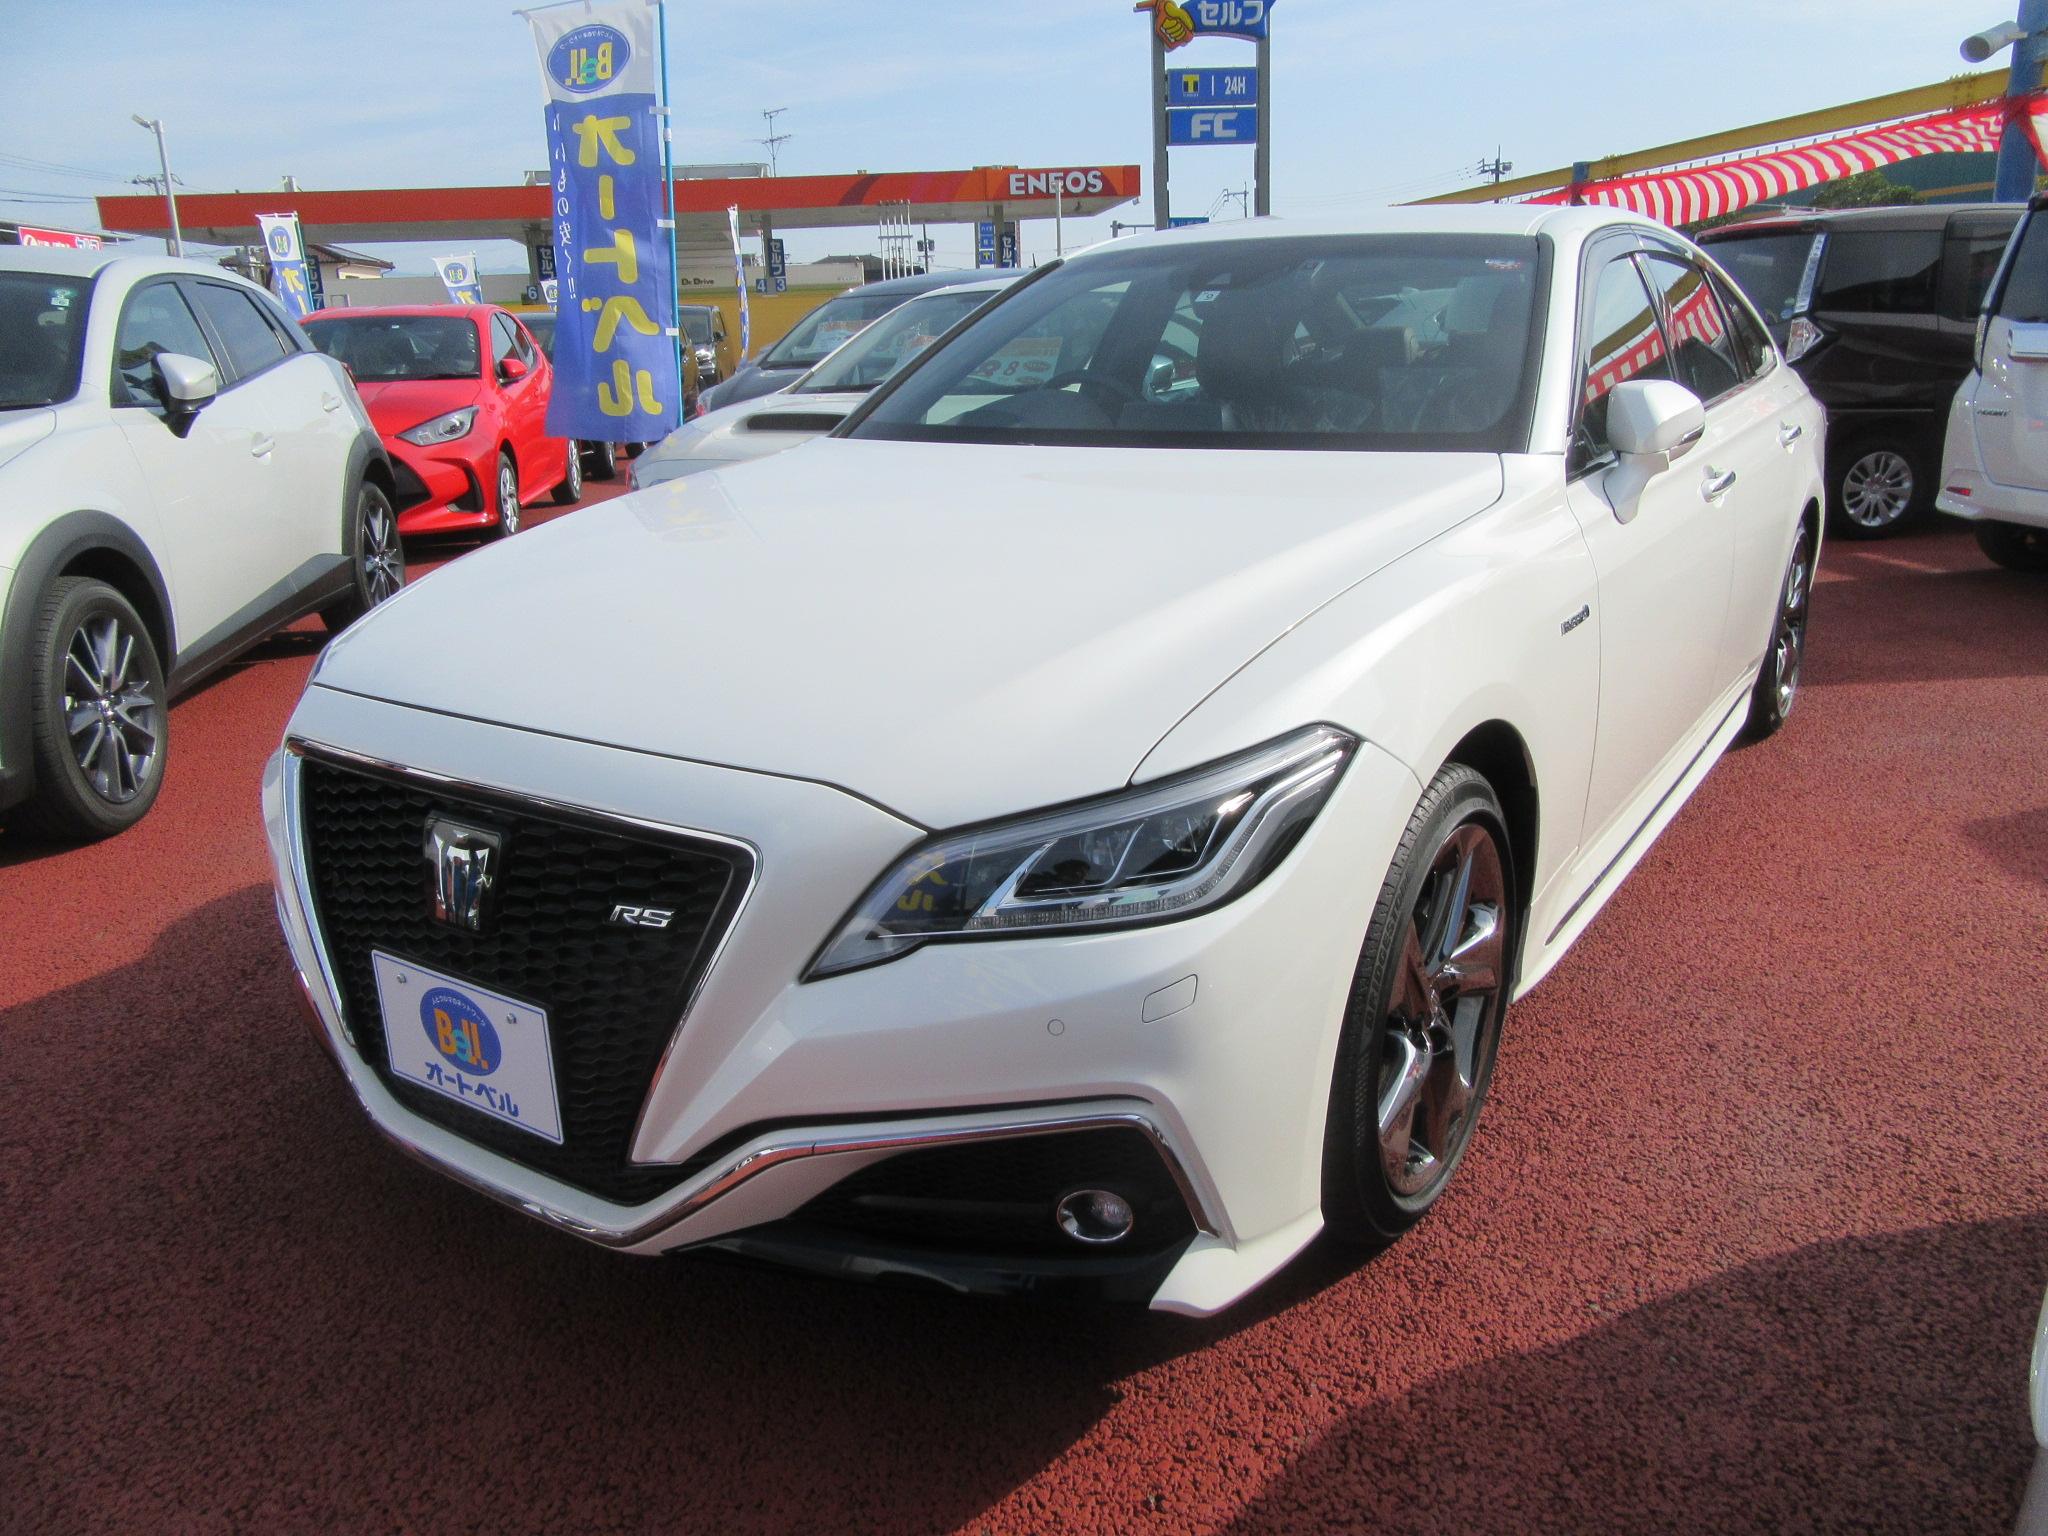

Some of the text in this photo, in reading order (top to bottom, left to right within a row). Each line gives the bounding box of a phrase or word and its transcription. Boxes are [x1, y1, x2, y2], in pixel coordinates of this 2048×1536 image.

[1197, 0, 1264, 26] セルフ
[1224, 75, 1246, 95] 24H
[1191, 112, 1238, 138] FC
[1009, 170, 1103, 196] ENEOS
[770, 240, 784, 276] セルフ
[528, 287, 538, 300] 6
[757, 280, 766, 292] 4
[777, 279, 786, 292] 3
[610, 904, 675, 928] RS
[425, 1061, 519, 1117] オートベル
